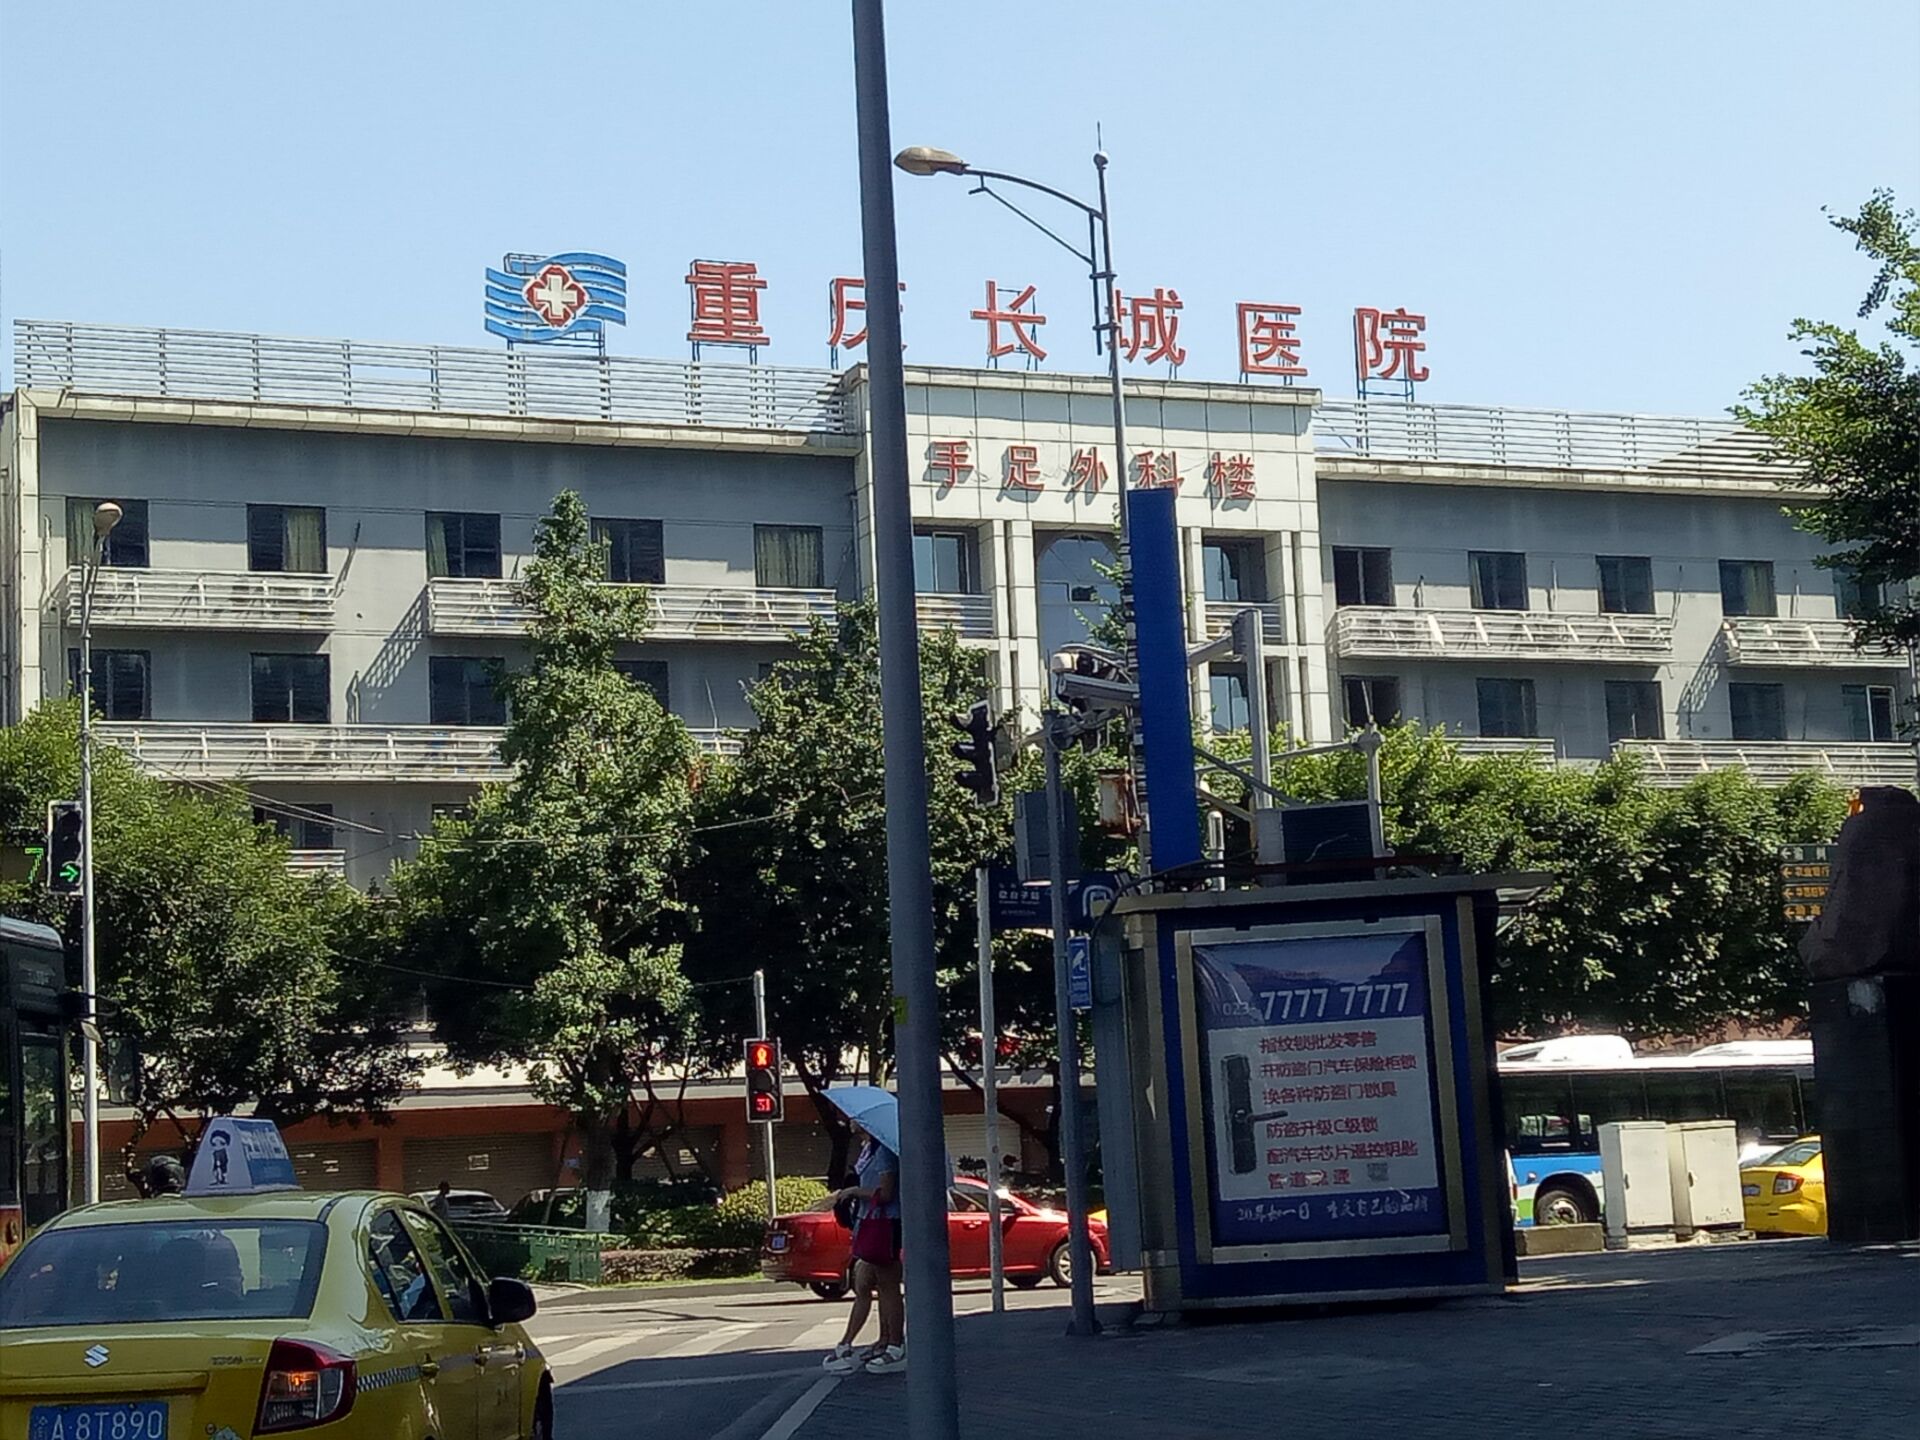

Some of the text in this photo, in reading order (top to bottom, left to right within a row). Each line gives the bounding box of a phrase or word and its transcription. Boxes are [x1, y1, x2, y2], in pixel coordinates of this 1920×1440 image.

[930, 440, 1257, 499] 手足外科楼
[24, 847, 44, 884] 7
[1340, 983, 1409, 1016] 7777
[1259, 1030, 1377, 1054] 指纹锁批发零售
[1260, 1053, 1417, 1078] 开防盗门汽车保险柜锁
[1266, 1116, 1378, 1139] 防盗升级C级锁
[1266, 1140, 1418, 1165] 配汽车芯片遥控钥匙
